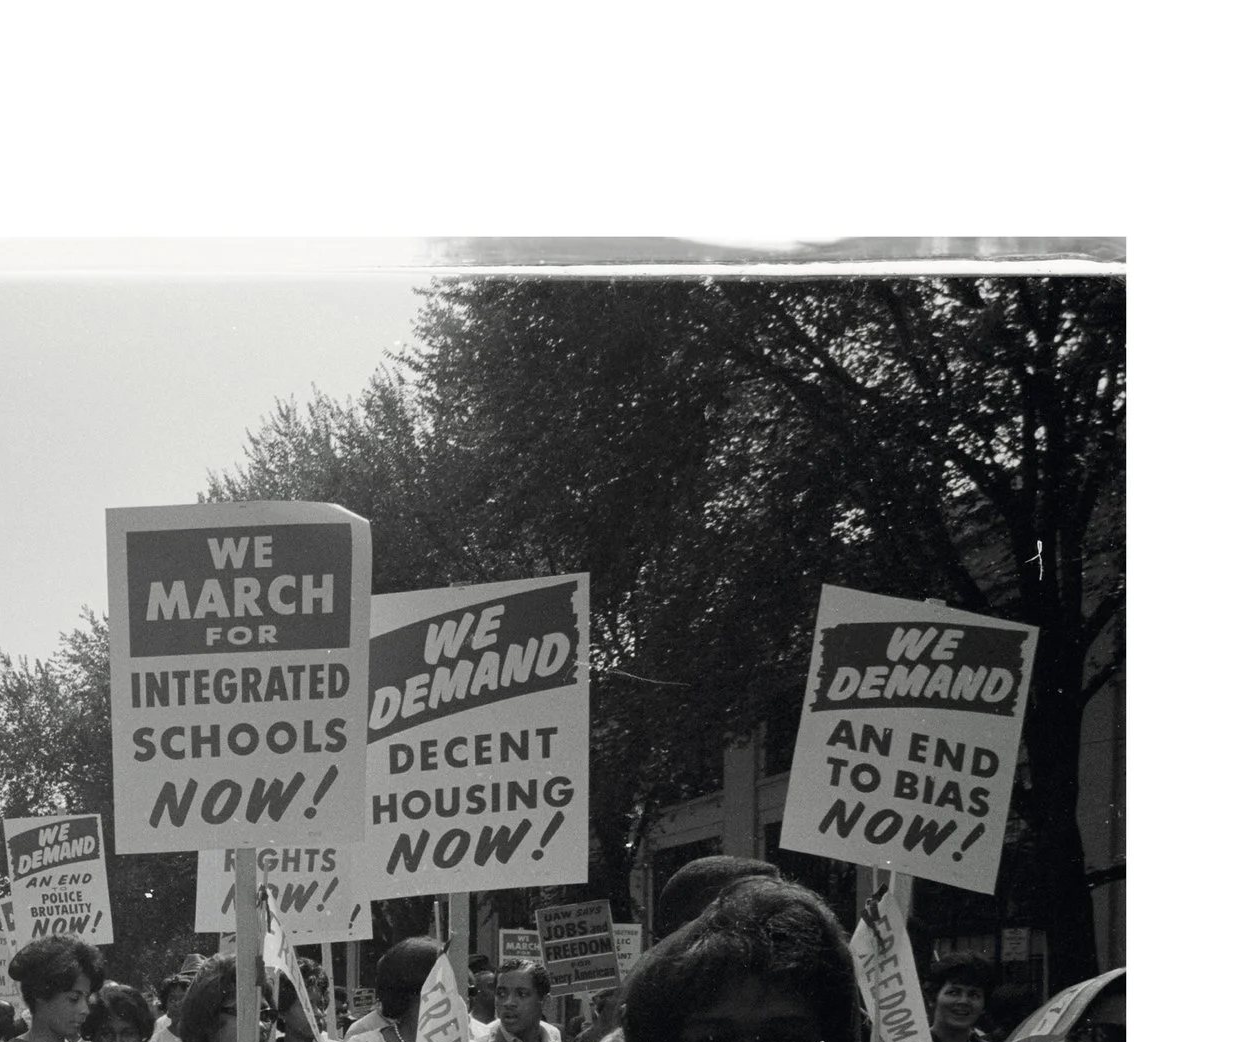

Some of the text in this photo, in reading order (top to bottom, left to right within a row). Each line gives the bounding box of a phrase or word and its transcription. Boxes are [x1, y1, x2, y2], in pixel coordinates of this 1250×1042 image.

[207, 535, 273, 570] WE
[145, 573, 334, 622] MARCH
[205, 625, 278, 646] FOR
[422, 604, 505, 665] WE
[886, 626, 965, 662] WE
[131, 663, 350, 708] INTEGRATED
[368, 632, 571, 731] DEMAND
[826, 664, 1015, 702] DEMAND
[132, 717, 347, 762] SCHOOLS
[388, 727, 558, 775] DECENT
[826, 719, 1000, 779] AN END
[149, 764, 339, 829] NOW!
[372, 776, 575, 825] HOUSING
[826, 756, 990, 818] TO BIAS
[38, 823, 70, 847] WE
[386, 811, 565, 876] NOW!
[818, 798, 986, 863] NOW!
[18, 835, 96, 874] DEMAND
[25, 873, 93, 889] AN END
[41, 891, 83, 905] POLICE
[29, 903, 92, 918] BRUTALITY
[31, 910, 103, 938] NOW!
[544, 911, 571, 921] UAW
[505, 942, 541, 951] MARCH
[543, 920, 588, 942] JOBS
[544, 937, 613, 960] FREEDOM
